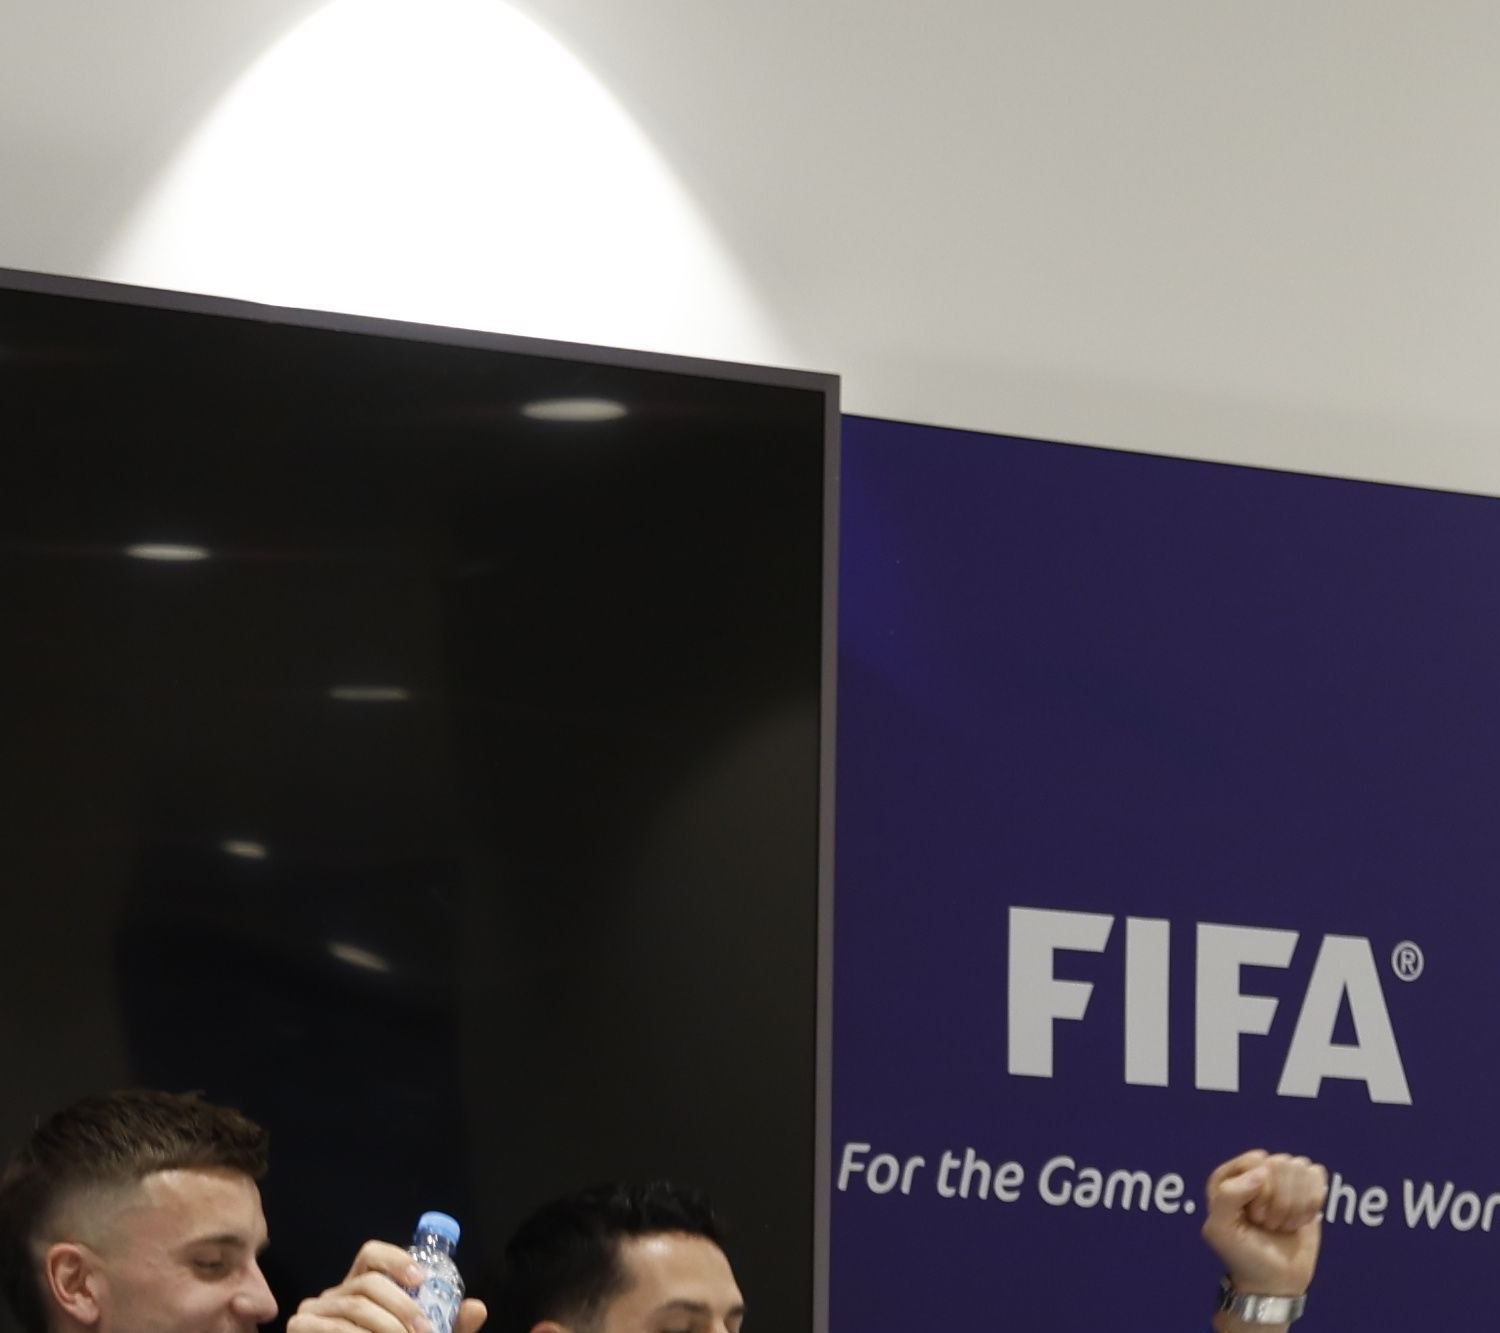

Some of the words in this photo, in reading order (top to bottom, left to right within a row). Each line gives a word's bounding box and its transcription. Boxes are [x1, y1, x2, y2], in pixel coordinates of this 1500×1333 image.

[837, 1141, 925, 1195] For
[936, 1146, 1025, 1203] the
[1038, 1155, 1196, 1214] Game.
[1317, 1172, 1389, 1227] he
